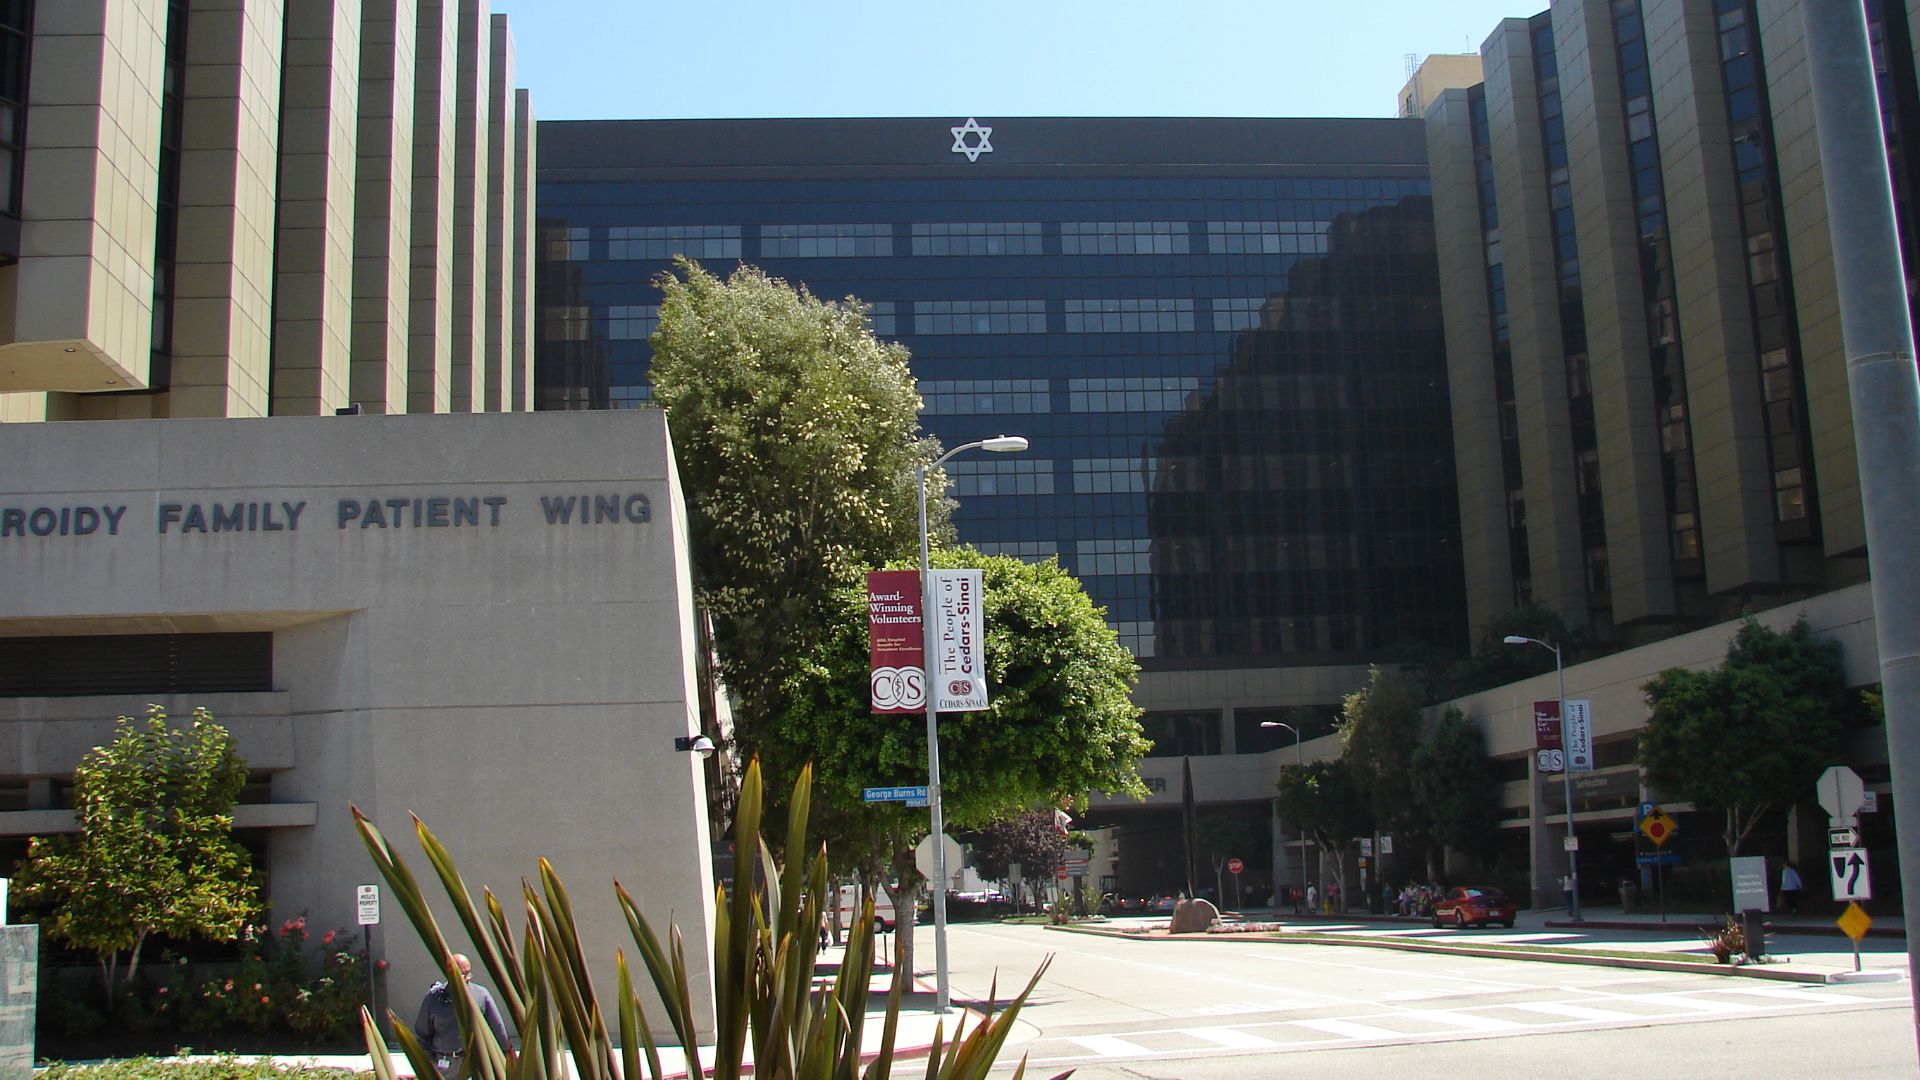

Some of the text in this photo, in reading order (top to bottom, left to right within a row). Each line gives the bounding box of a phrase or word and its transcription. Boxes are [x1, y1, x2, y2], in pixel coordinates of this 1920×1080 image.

[2, 494, 651, 537] ROIDY FAMILY PATIENT WING
[869, 591, 904, 602] Award-
[869, 603, 913, 615] Winning
[869, 614, 921, 624] Volunteers
[940, 577, 956, 674] The People of
[957, 578, 971, 674] Cedars-Sinai
[1570, 715, 1578, 737] People
[1576, 704, 1586, 754] Cedars-Sinai
[866, 788, 926, 800] George Burns Rd
[1831, 834, 1850, 843] ONE WAY
